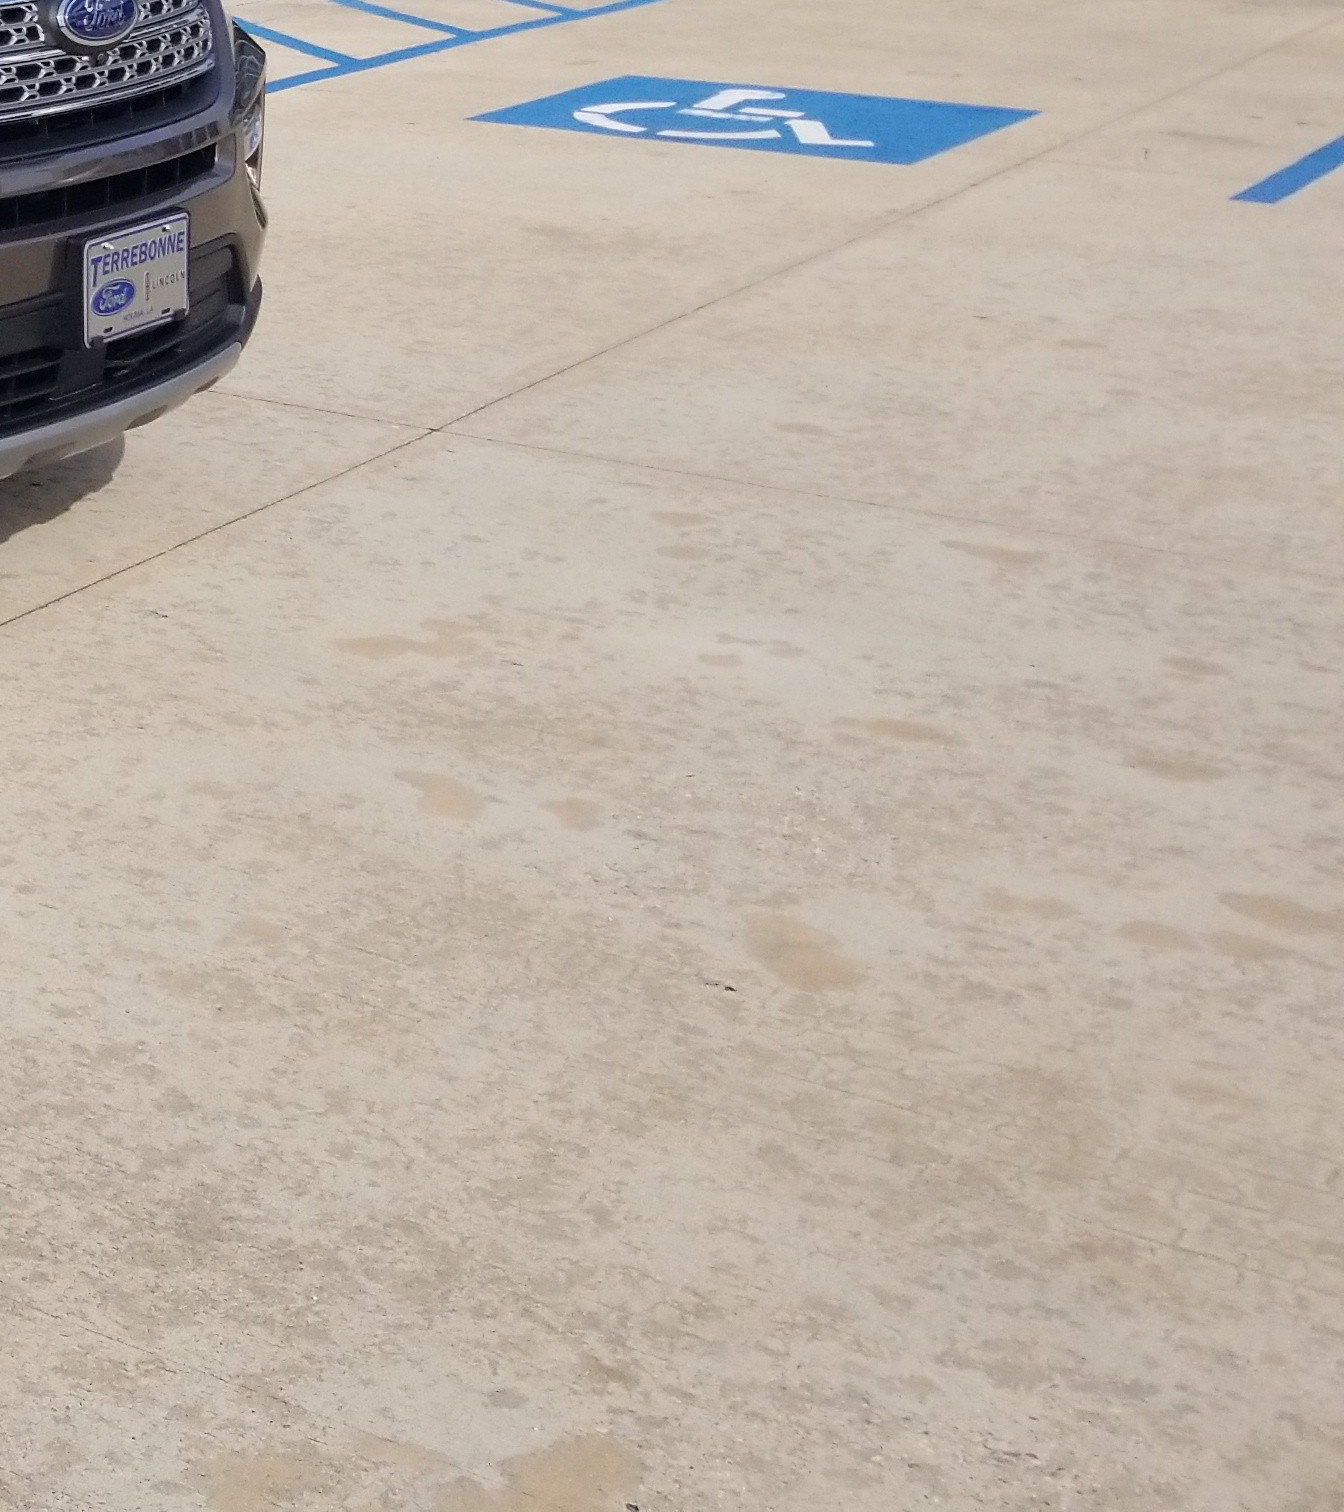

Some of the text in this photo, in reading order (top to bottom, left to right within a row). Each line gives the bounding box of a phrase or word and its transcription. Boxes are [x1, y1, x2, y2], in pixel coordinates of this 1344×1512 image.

[90, 231, 185, 288] TERREBONNE
[152, 269, 186, 289] LINCOLN
[99, 284, 128, 311] Ford
